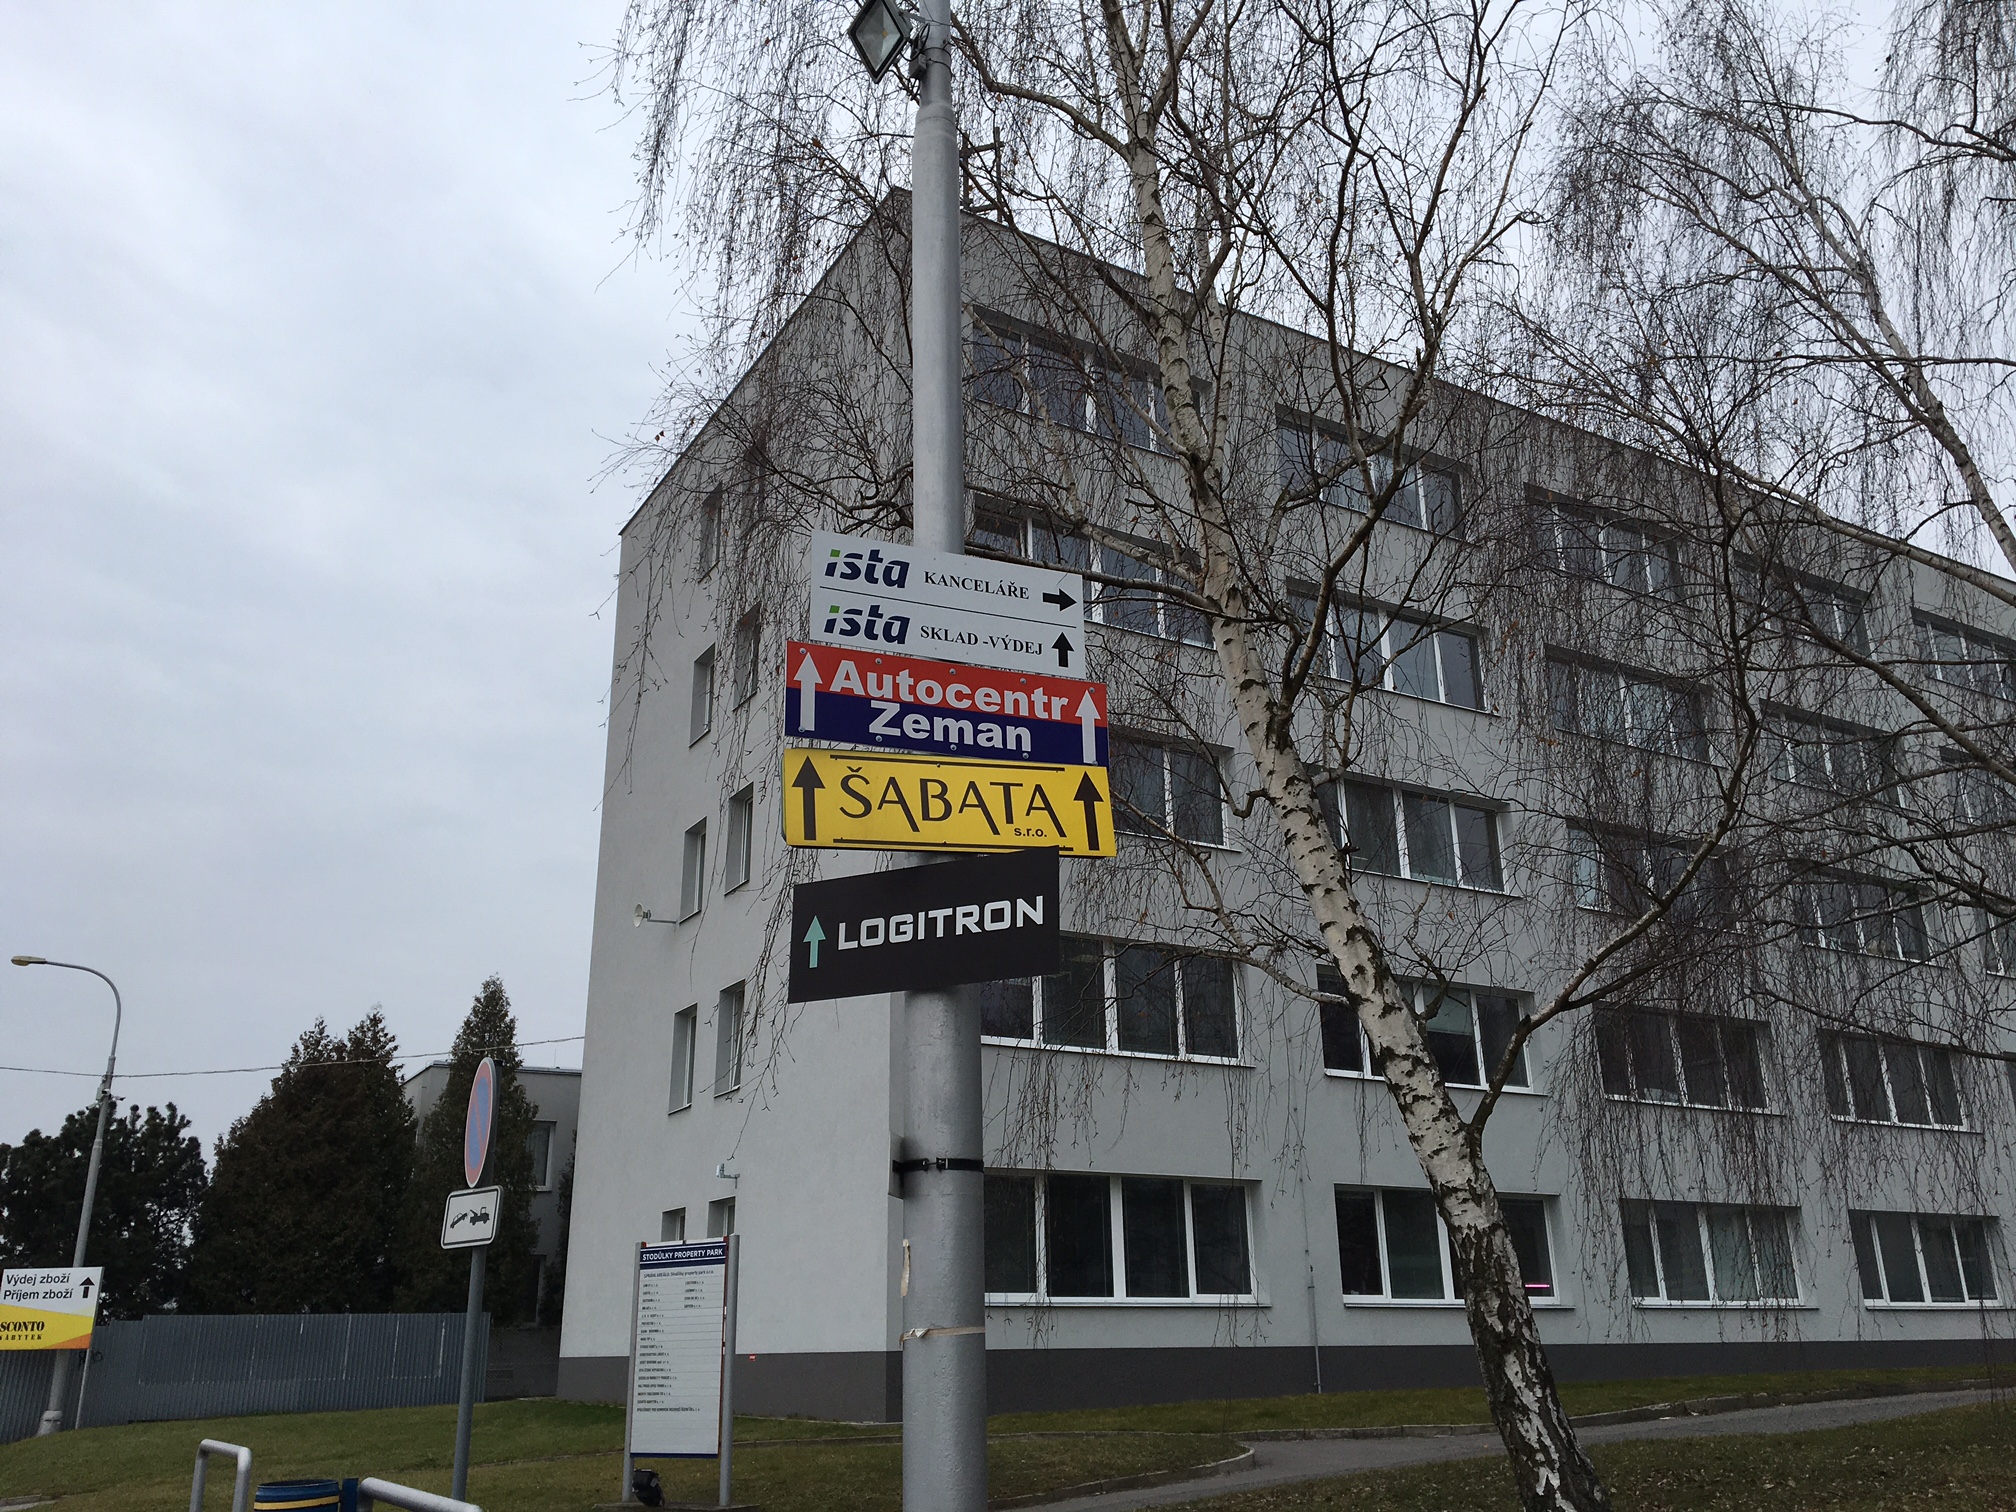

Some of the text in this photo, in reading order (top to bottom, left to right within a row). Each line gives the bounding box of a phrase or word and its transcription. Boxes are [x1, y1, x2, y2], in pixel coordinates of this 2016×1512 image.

[824, 549, 1030, 600] ista KANCELÁŘE
[823, 604, 910, 645] ista
[920, 625, 979, 645] SKLAD
[829, 660, 1068, 720] Autocentr
[868, 699, 1032, 752] Zeman
[839, 766, 1067, 838] ŠABATA
[1013, 827, 1048, 838] s.r.o.
[838, 896, 1044, 950] LOGITRON
[674, 1250, 705, 1258] PROPERTY
[3, 1288, 74, 1302] Příjem zboží
[6, 1273, 71, 1286] Výdej zboží
[0, 1321, 45, 1332] SCONTO
